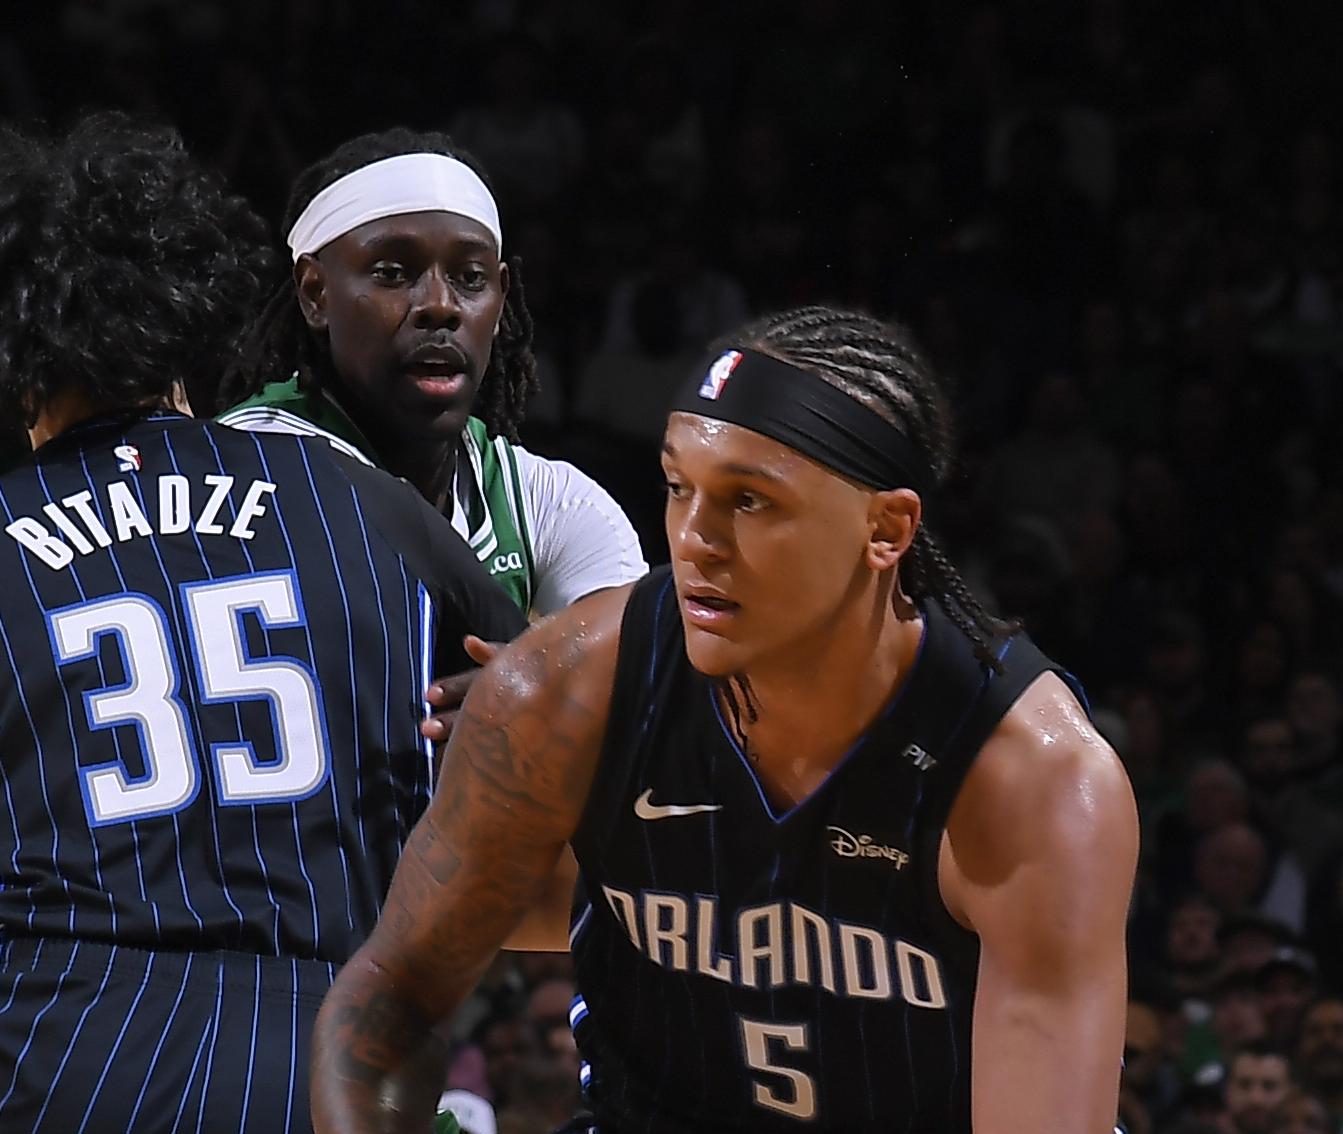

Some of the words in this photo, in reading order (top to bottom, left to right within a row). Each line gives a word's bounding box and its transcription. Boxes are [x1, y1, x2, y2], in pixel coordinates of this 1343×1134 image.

[5, 474, 277, 571] BITADZE
[489, 551, 523, 575] ca
[46, 568, 332, 827] 35
[825, 825, 910, 871] Disney
[602, 884, 947, 1011] ORLANDO
[741, 1018, 816, 1120] 5
